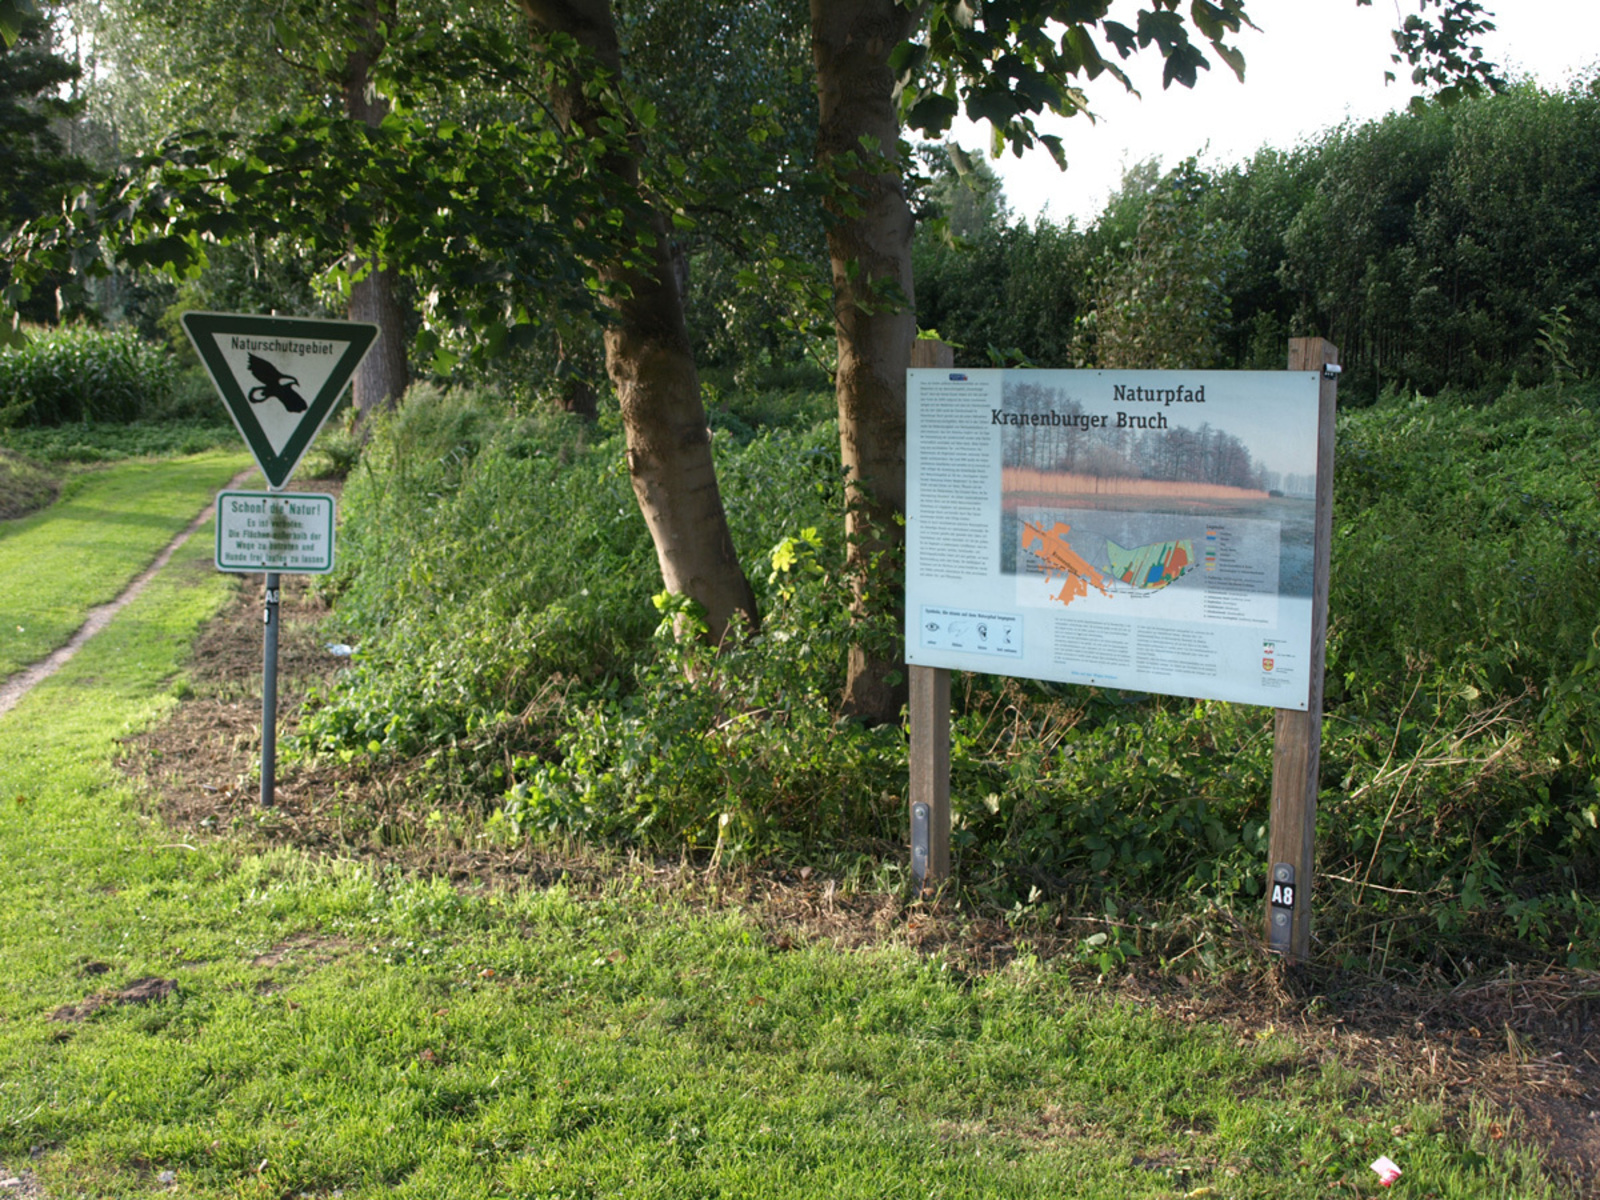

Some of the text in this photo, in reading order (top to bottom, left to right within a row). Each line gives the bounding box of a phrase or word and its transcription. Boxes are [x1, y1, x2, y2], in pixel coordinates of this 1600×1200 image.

[231, 336, 333, 356] Naturschutzgebiet
[1113, 384, 1206, 406] Naturpfad
[991, 409, 1168, 431] Kranenburger Bruch
[231, 501, 321, 515] Schont die Natur!
[247, 518, 256, 527] Es
[258, 519, 269, 528] ist
[228, 529, 240, 539] Die
[243, 530, 271, 540] Flächen
[310, 533, 322, 542] der
[236, 541, 255, 551] Wege
[257, 543, 267, 551] zu
[302, 544, 315, 552] und
[225, 552, 325, 565] Hunde frei laufen zu lassen
[1272, 885, 1293, 905] A8
